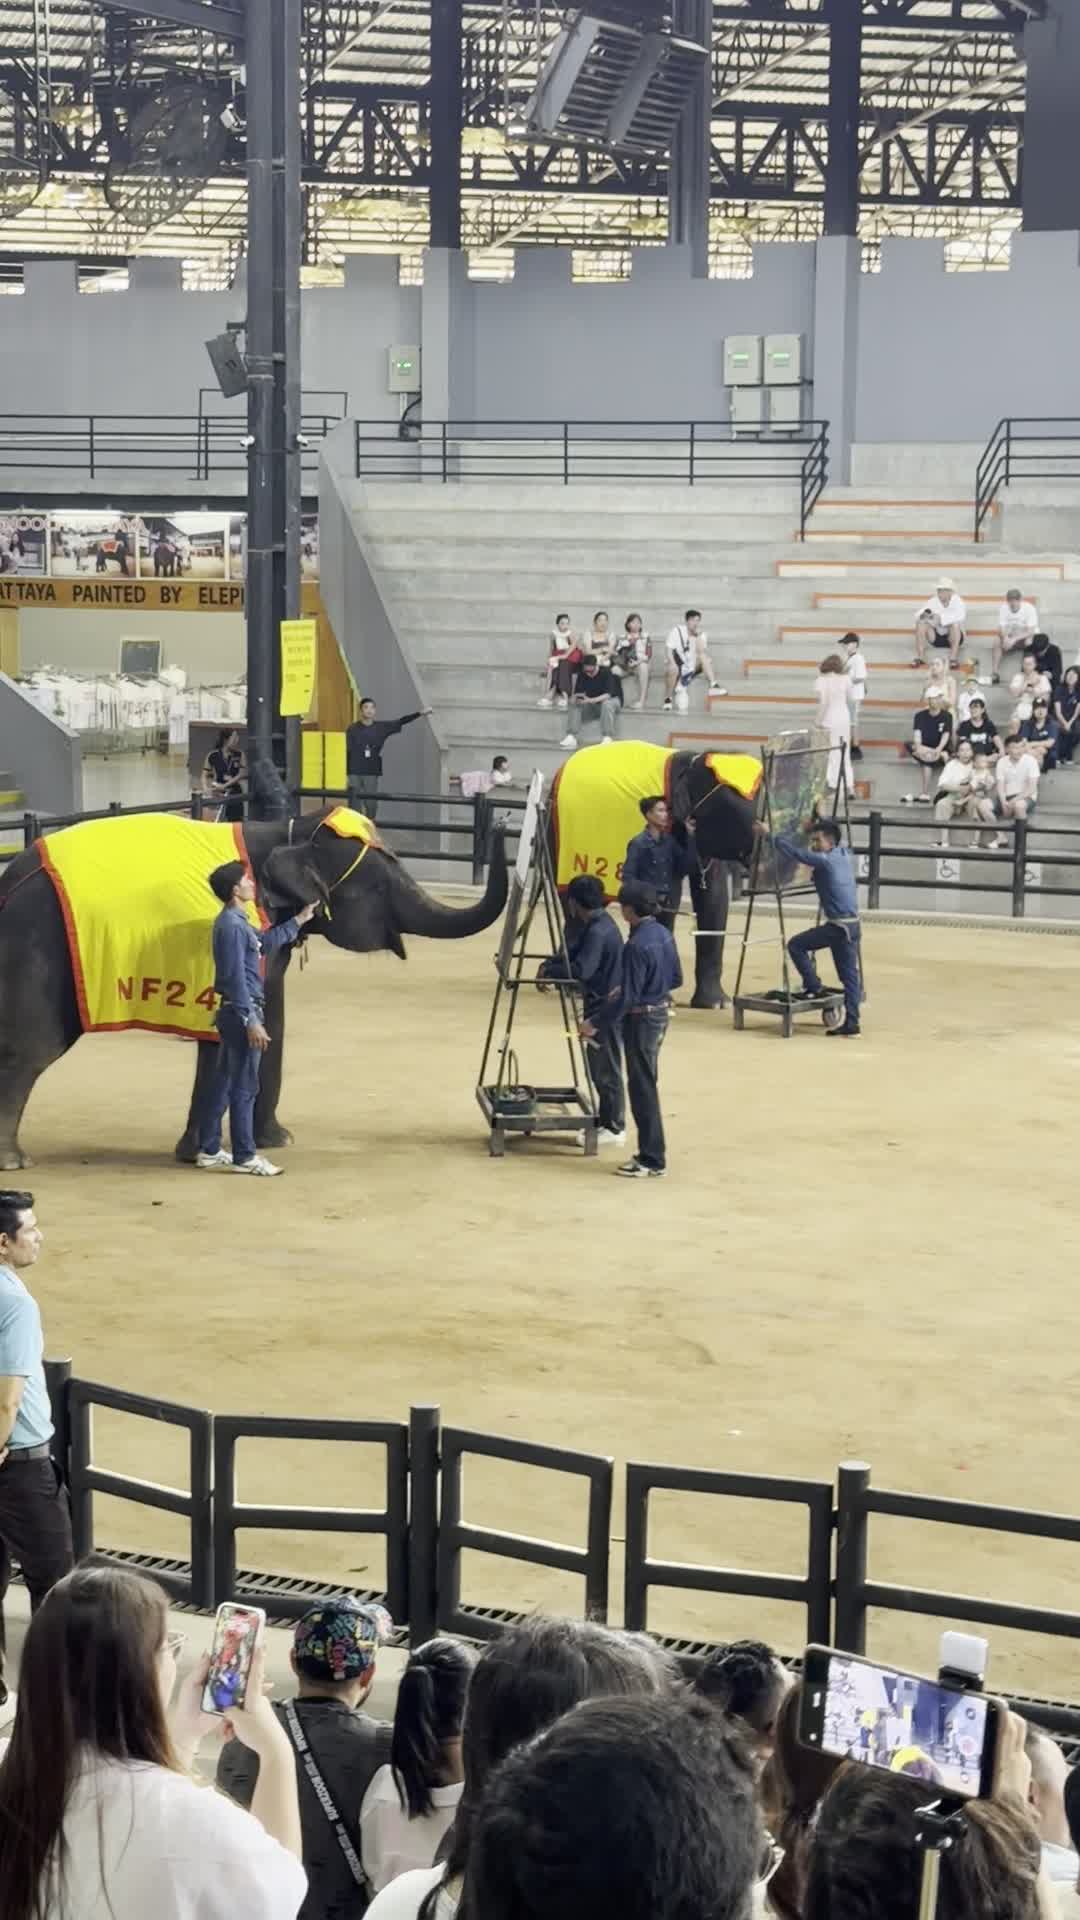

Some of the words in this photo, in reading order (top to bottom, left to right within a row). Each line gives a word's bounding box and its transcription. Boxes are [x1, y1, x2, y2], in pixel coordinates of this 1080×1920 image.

[72, 585, 146, 603] PAINTED
[160, 586, 182, 604] BY
[117, 976, 217, 1011] NF24
